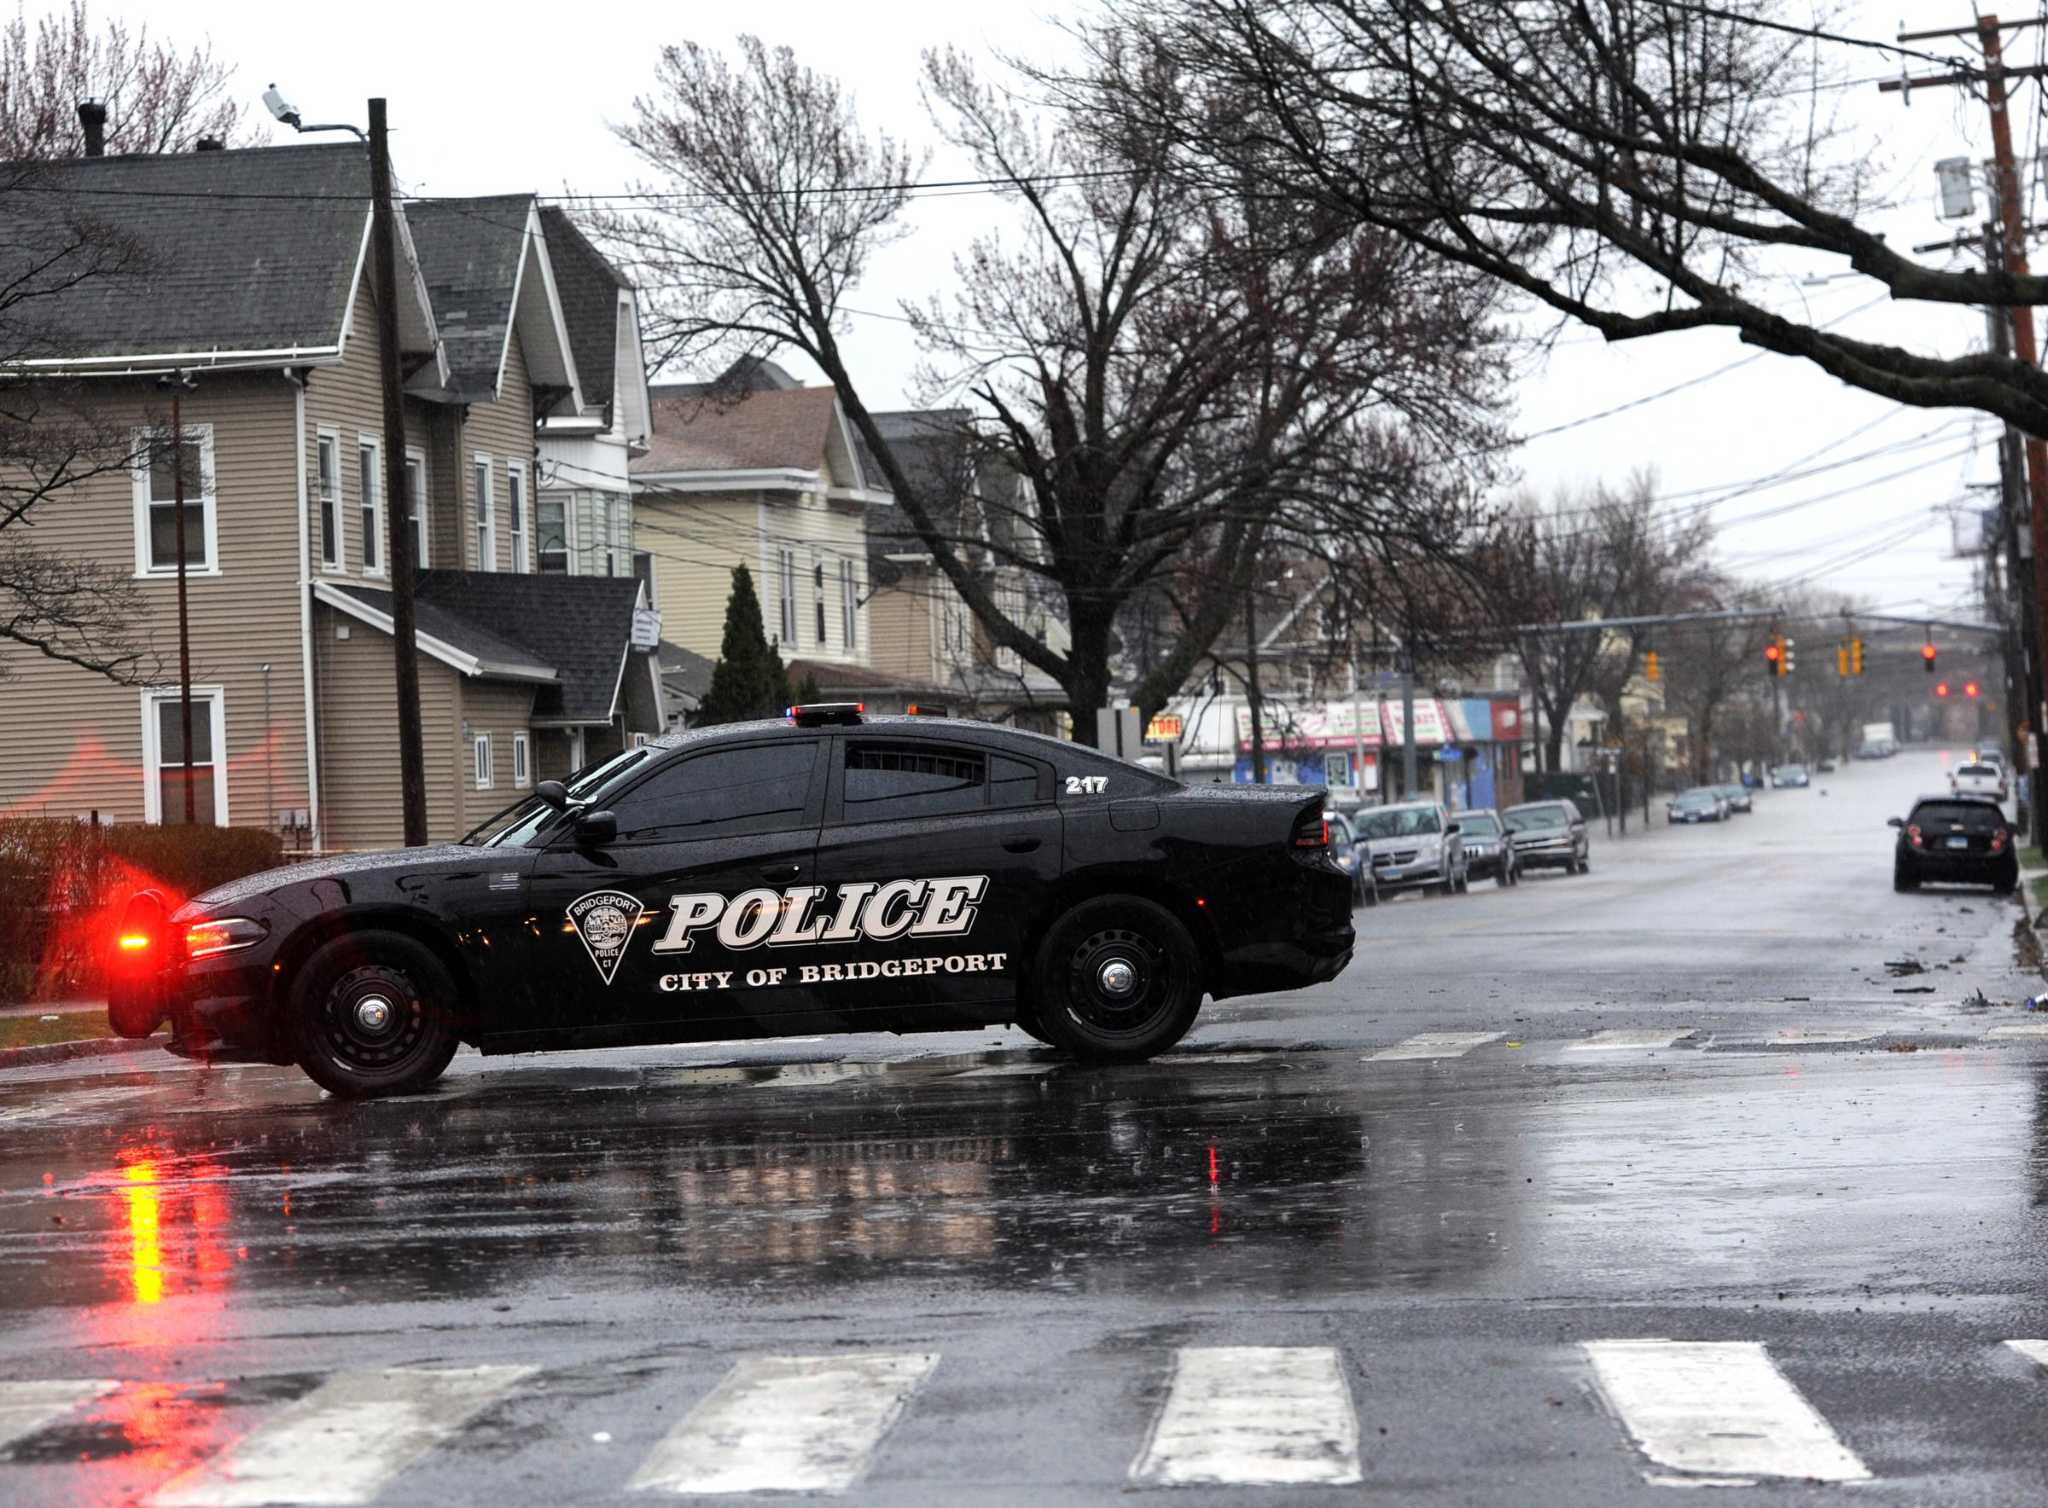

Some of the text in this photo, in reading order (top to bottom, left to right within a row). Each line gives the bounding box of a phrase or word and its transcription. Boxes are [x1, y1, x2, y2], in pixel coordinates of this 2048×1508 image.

[1147, 719, 1181, 736] TORE
[1065, 776, 1109, 794] 217
[573, 895, 637, 916] BRIDGEPORT
[652, 875, 990, 955] POLICE
[595, 948, 619, 958] POLICE
[603, 959, 612, 968] CT
[659, 953, 1007, 992] CITY OF BRIDGEPORT
